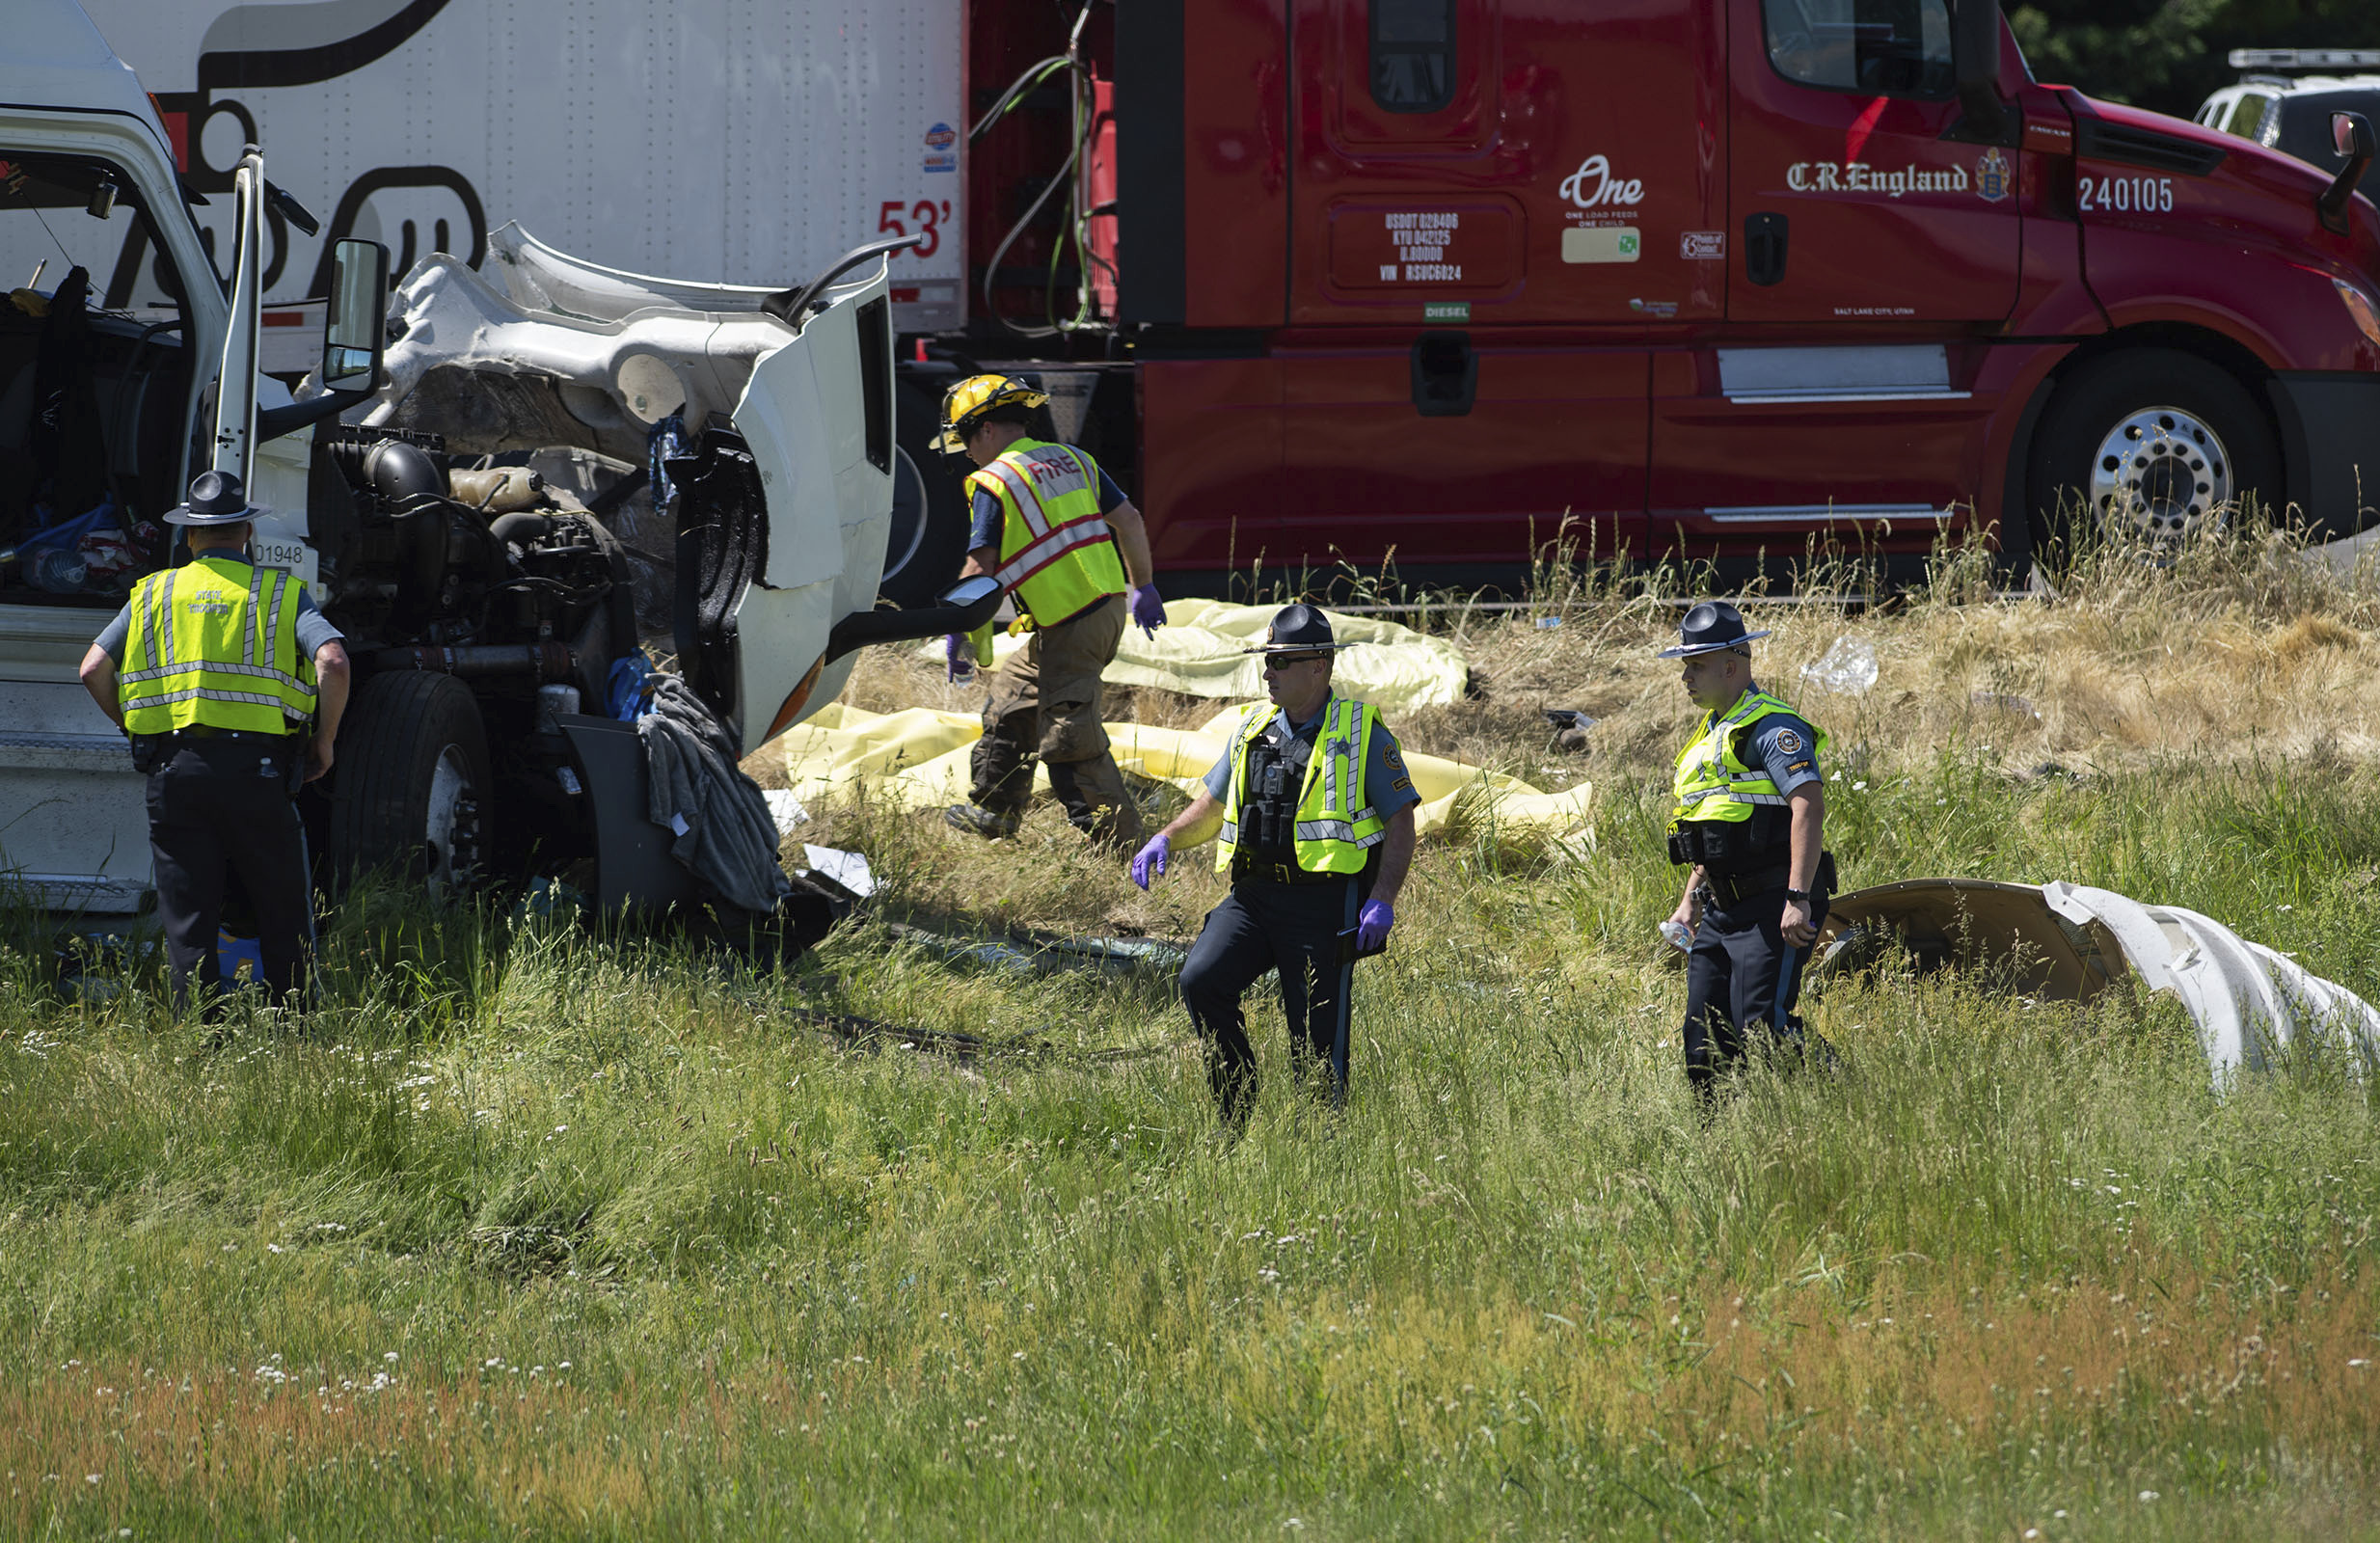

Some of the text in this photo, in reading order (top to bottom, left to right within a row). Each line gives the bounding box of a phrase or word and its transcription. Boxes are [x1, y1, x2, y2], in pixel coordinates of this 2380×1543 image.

[1558, 154, 1645, 208] One
[2079, 177, 2173, 212] 240105
[1386, 213, 1418, 230] USDOT
[1585, 211, 1609, 220] LOAD
[1393, 230, 1413, 245] KYU
[1380, 264, 1397, 281] VIN
[1426, 308, 1469, 317] DIESEL
[1834, 307, 1852, 315] SALT
[1853, 307, 1873, 315] LAKE
[1027, 455, 1081, 484] FIRE
[196, 590, 222, 601] STATE
[188, 604, 229, 614] TROOPER
